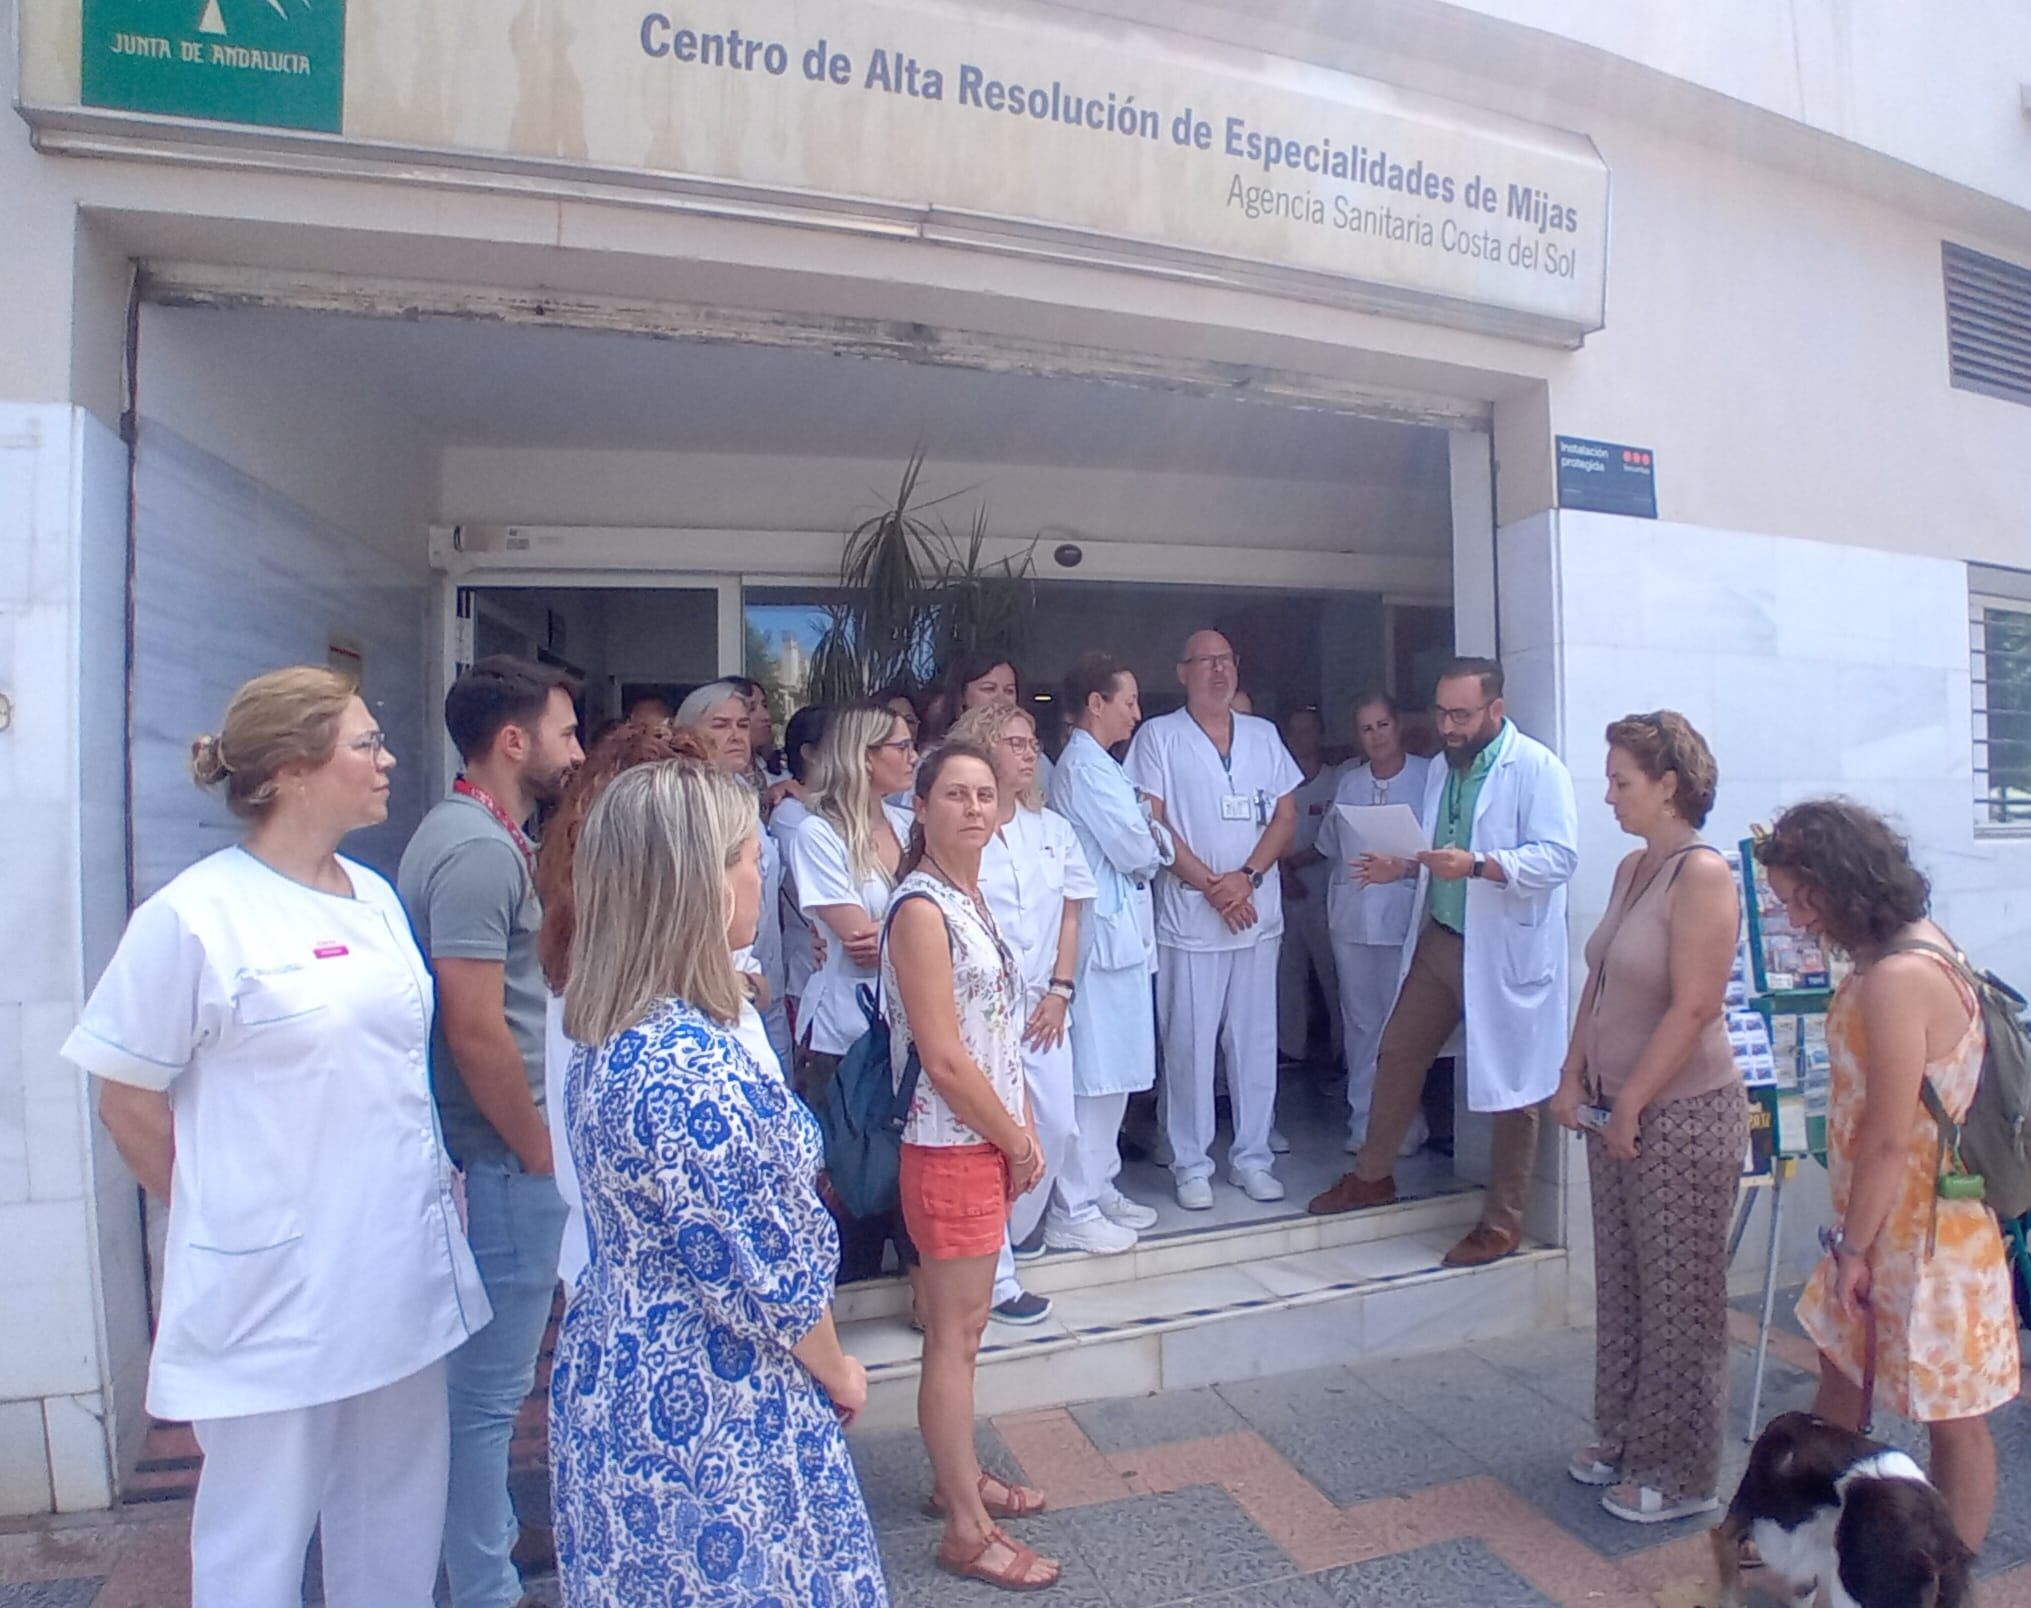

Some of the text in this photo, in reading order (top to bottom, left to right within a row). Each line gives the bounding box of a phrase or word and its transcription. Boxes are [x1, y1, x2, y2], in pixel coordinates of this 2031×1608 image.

[111, 32, 172, 60] JUNTA
[181, 41, 204, 64] DE
[640, 12, 1578, 235] Centro de Alta Resolución de Especialidades de Mijas
[1226, 174, 1575, 280] Agencia Sanitaria Costa del Sol
